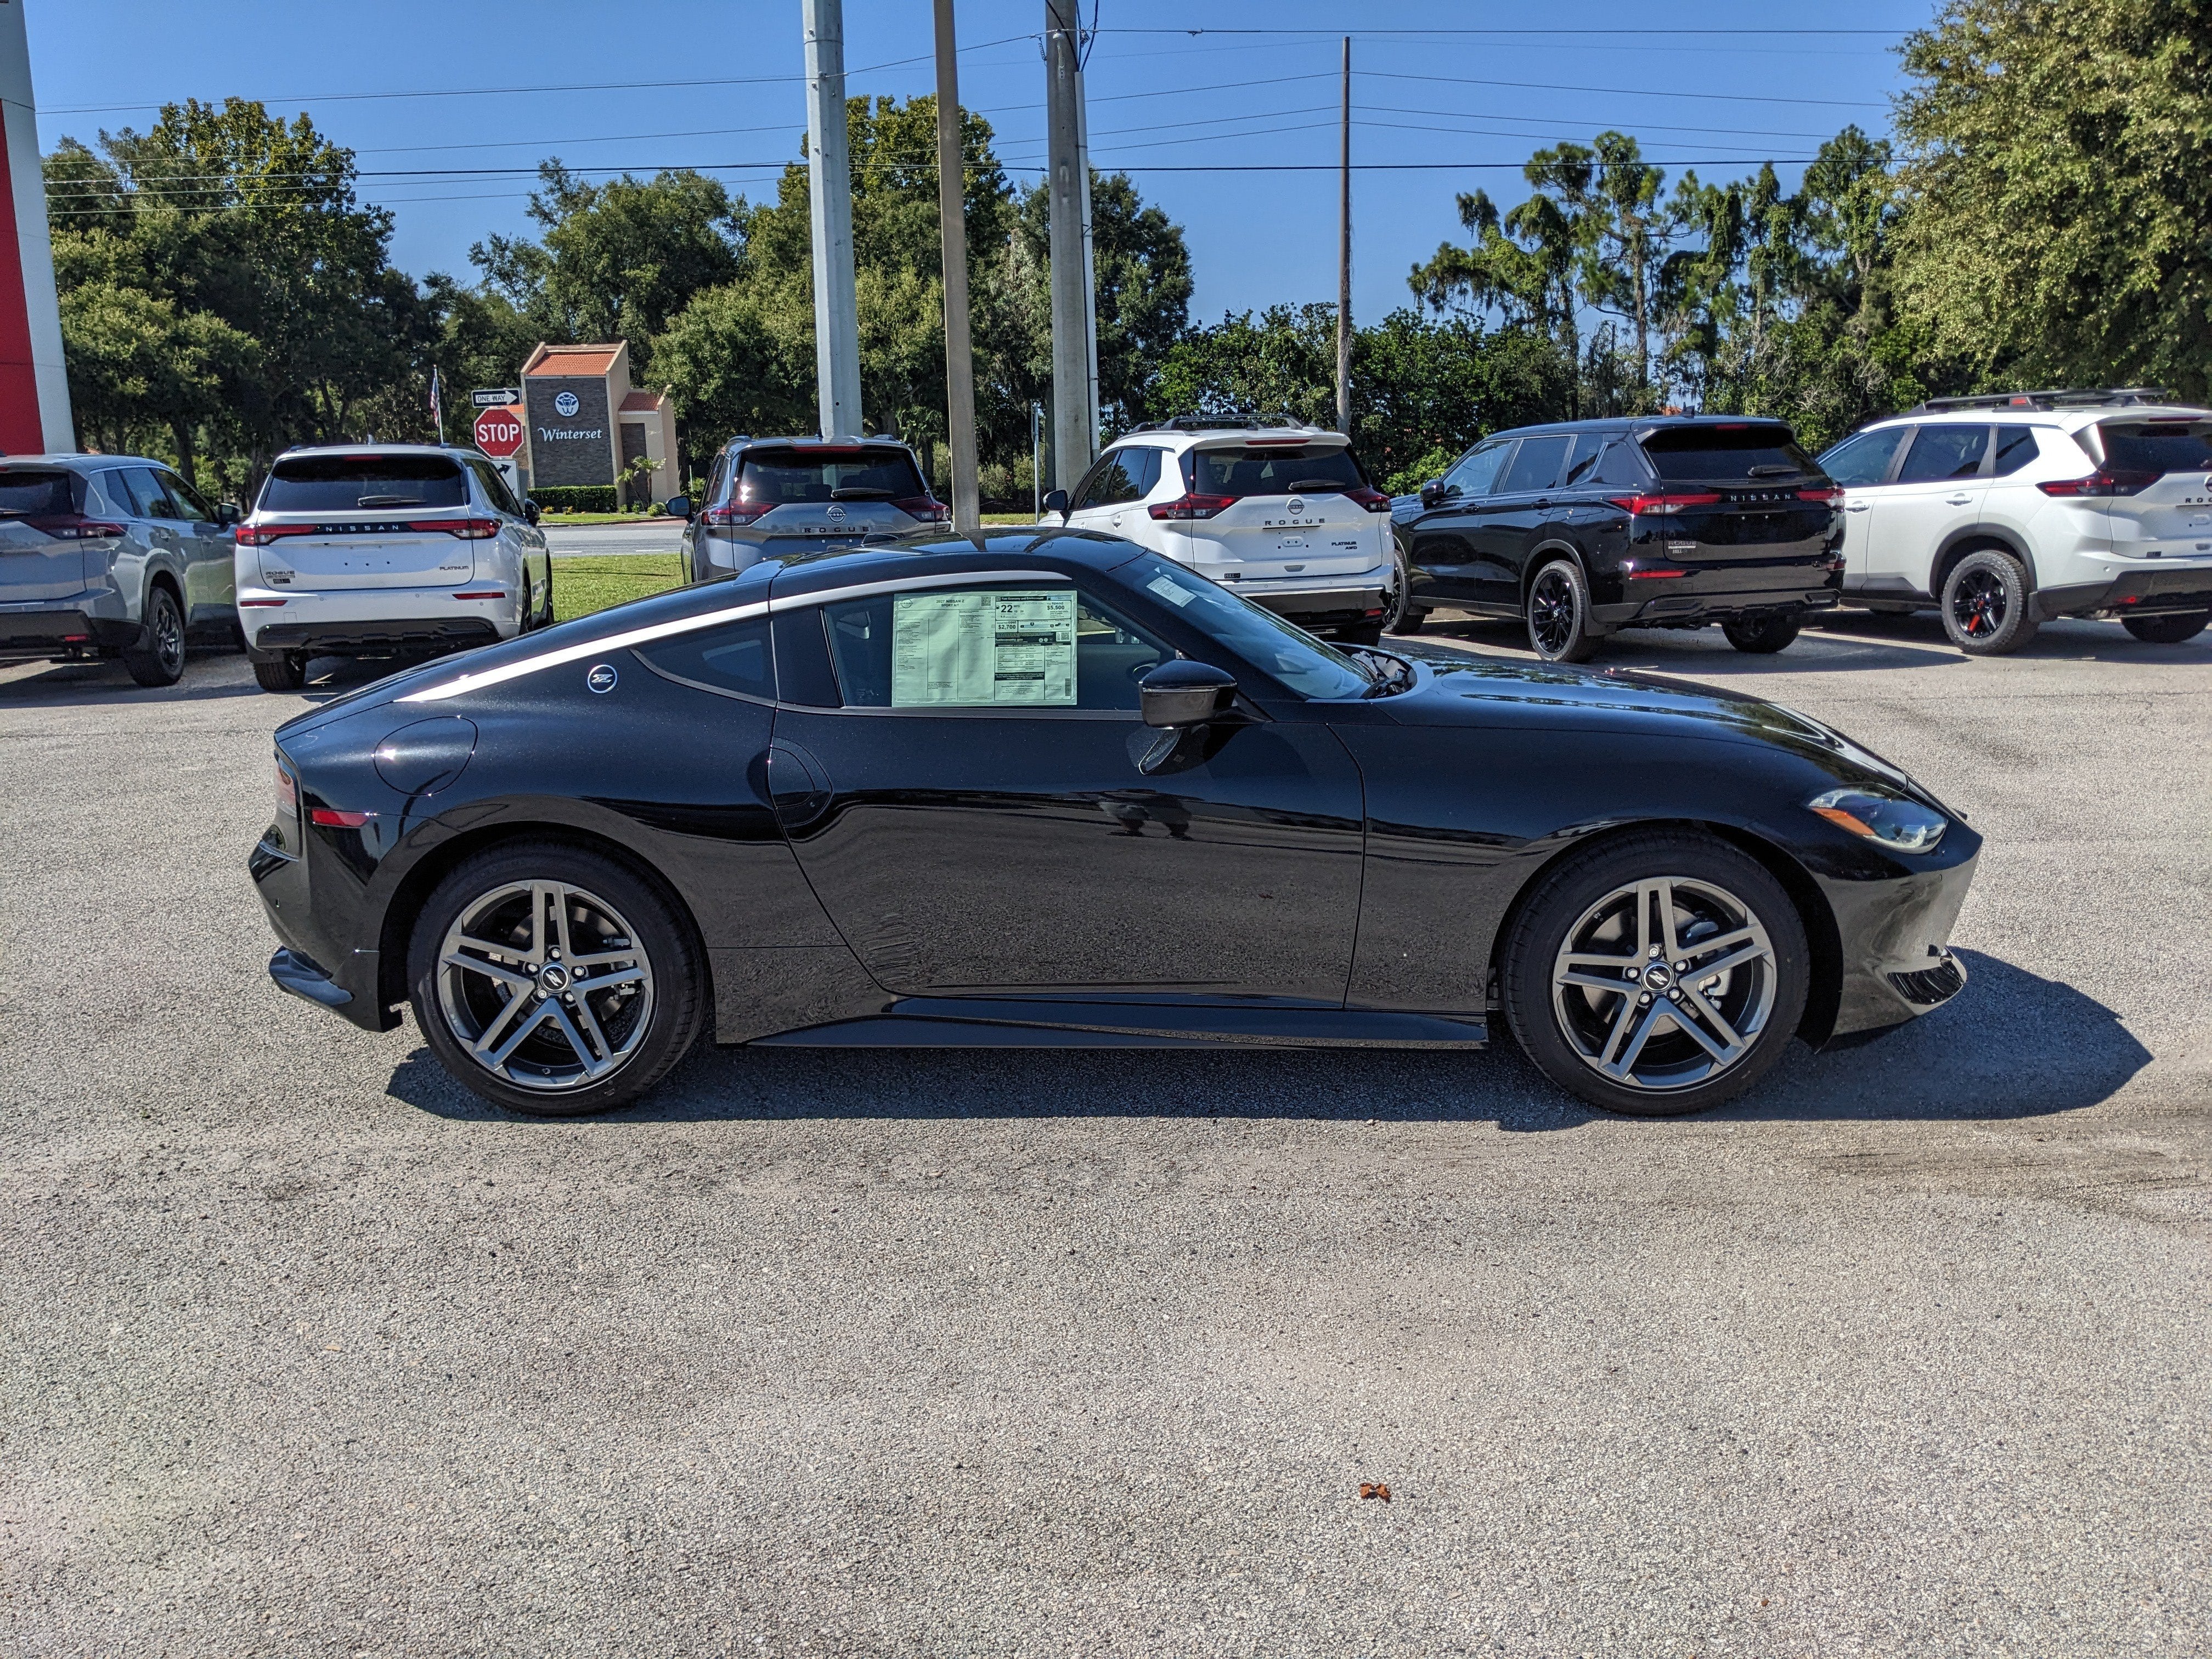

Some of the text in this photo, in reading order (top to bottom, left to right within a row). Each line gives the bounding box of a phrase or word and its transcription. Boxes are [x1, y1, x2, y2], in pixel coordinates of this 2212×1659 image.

[478, 424, 520, 442] STOP
[538, 427, 602, 442] Winterset
[1730, 494, 1791, 502] NISSAN
[1001, 605, 1013, 613] 22
